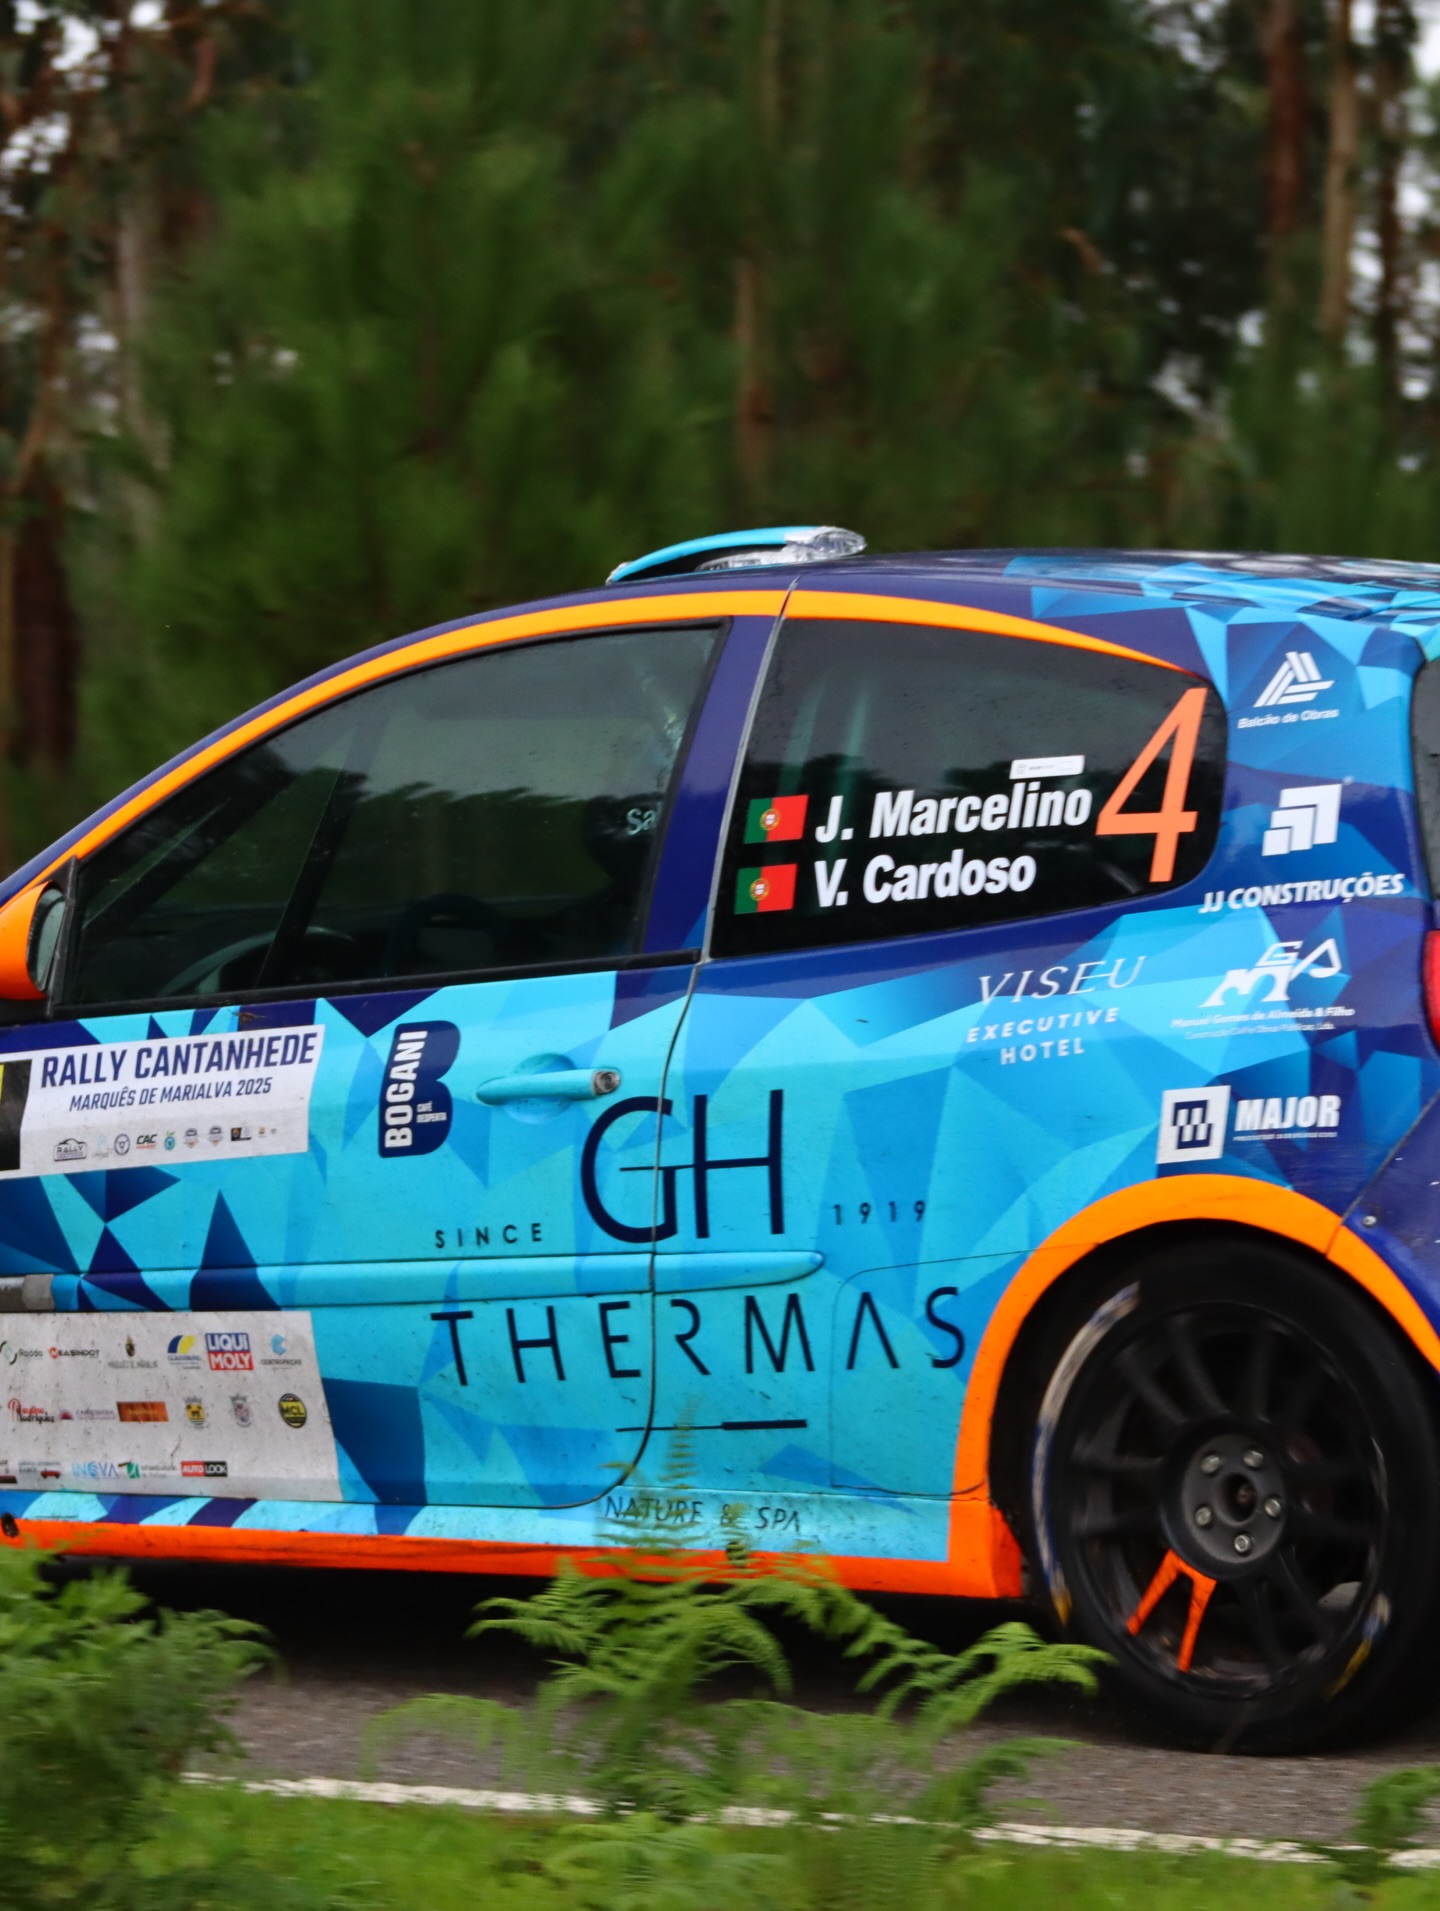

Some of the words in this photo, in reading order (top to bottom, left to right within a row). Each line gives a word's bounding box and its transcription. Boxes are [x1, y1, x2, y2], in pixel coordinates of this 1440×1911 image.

[1282, 710, 1298, 723] de
[1300, 707, 1340, 722] Obras
[1096, 687, 1208, 883] 4
[815, 796, 853, 844] J.
[869, 782, 1093, 839] Marcelino
[814, 858, 848, 909] V.
[863, 849, 1037, 902] Cardoso
[1198, 891, 1224, 914] JJ
[1228, 872, 1405, 910] CONSTRUÇÕES
[979, 956, 1147, 1006] VISEU
[966, 1008, 1119, 1043] EXECUTIVE
[41, 1049, 127, 1089] RALLY
[134, 1032, 318, 1079] CANTANHEDE
[1001, 1038, 1085, 1065] HOTEL
[69, 1086, 136, 1112] MARQUÊS
[139, 1088, 156, 1105] DE
[159, 1080, 232, 1103] MARIALVA
[236, 1077, 273, 1097] 2025
[385, 1030, 429, 1149] BOGANI
[1234, 1095, 1342, 1132] MAJOR
[136, 1134, 157, 1145] CAC
[581, 1089, 785, 1243] GH
[832, 1200, 925, 1226] 1919
[435, 1222, 543, 1250] SINCE
[207, 1334, 248, 1352] LIQUI
[430, 1286, 966, 1387] THERMAS
[210, 1352, 252, 1369] MOLY
[604, 1495, 704, 1525] NATURE
[754, 1506, 800, 1532] SPA
